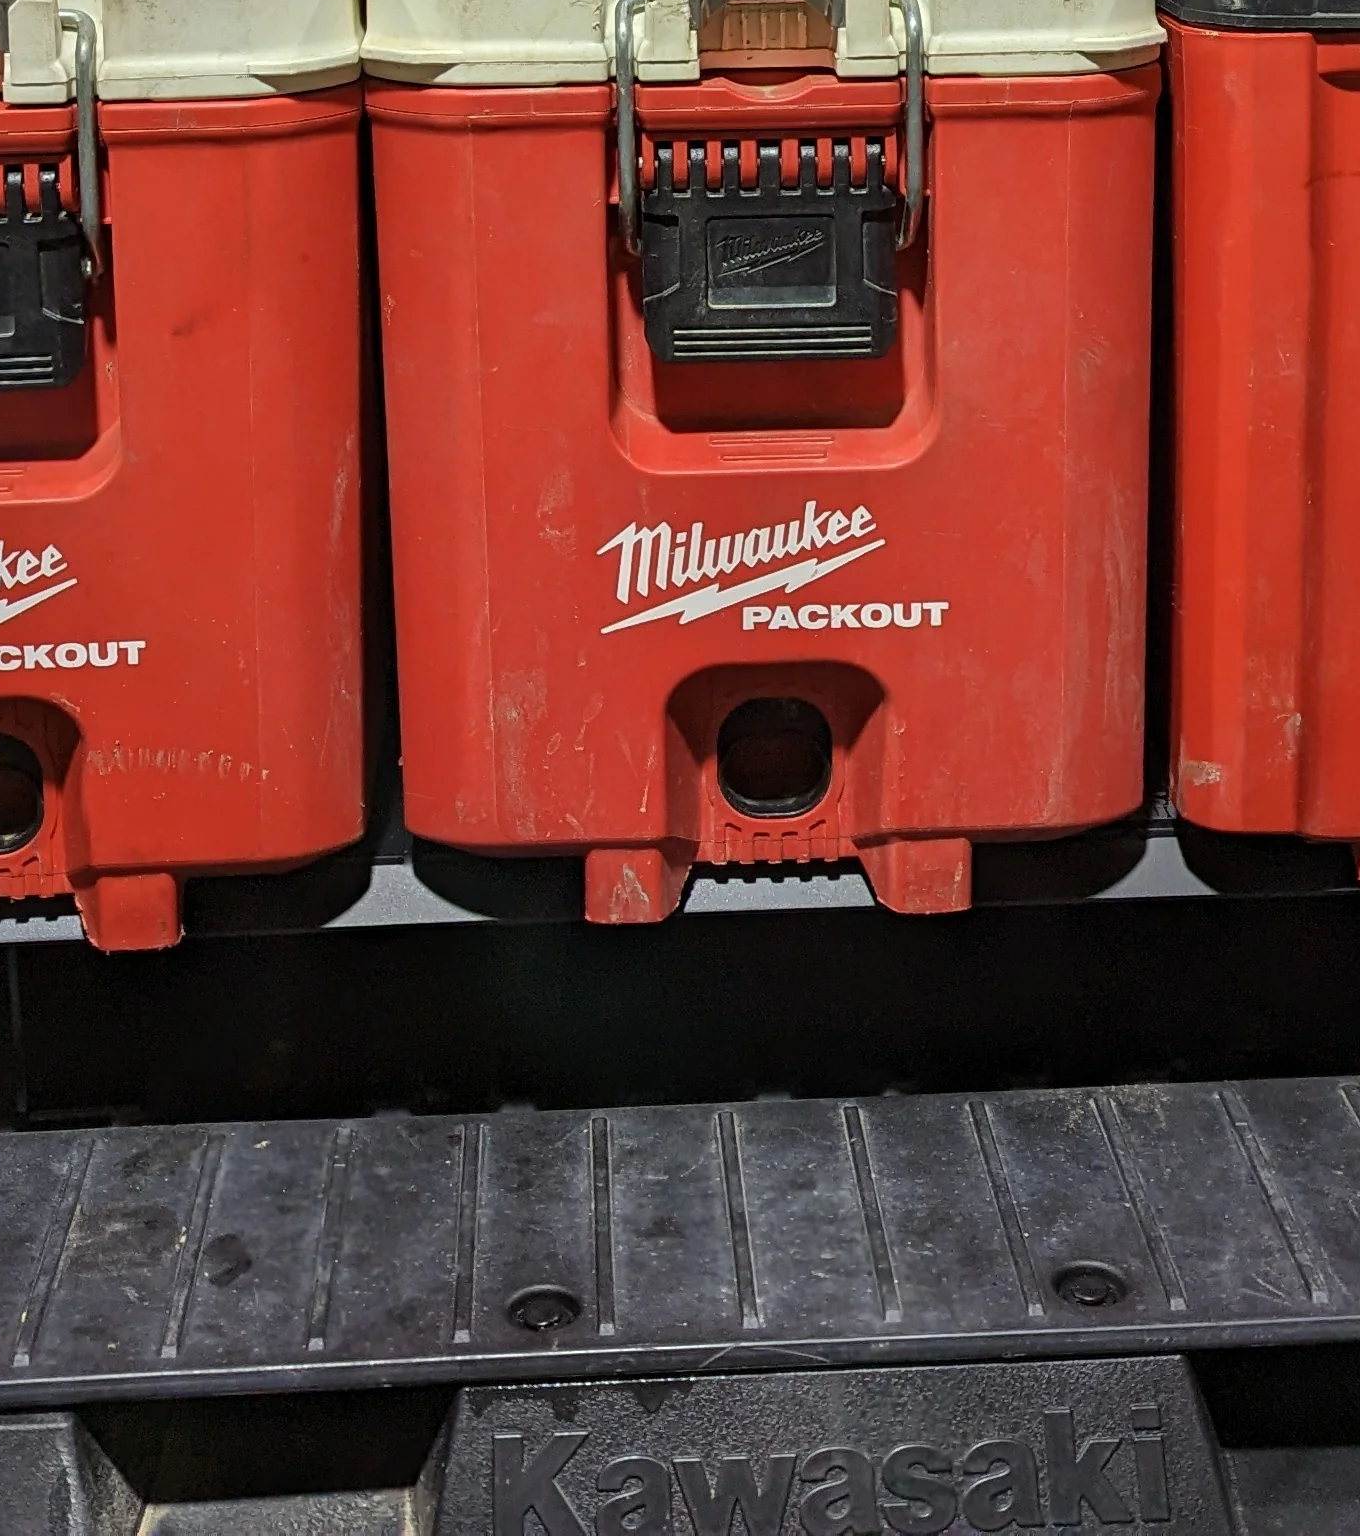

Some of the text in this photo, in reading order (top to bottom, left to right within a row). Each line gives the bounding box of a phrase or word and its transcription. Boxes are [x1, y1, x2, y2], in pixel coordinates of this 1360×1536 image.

[597, 500, 877, 604] Milwaukee
[742, 602, 949, 630] PACKOUT
[492, 1404, 1174, 1536] Kawasaki
